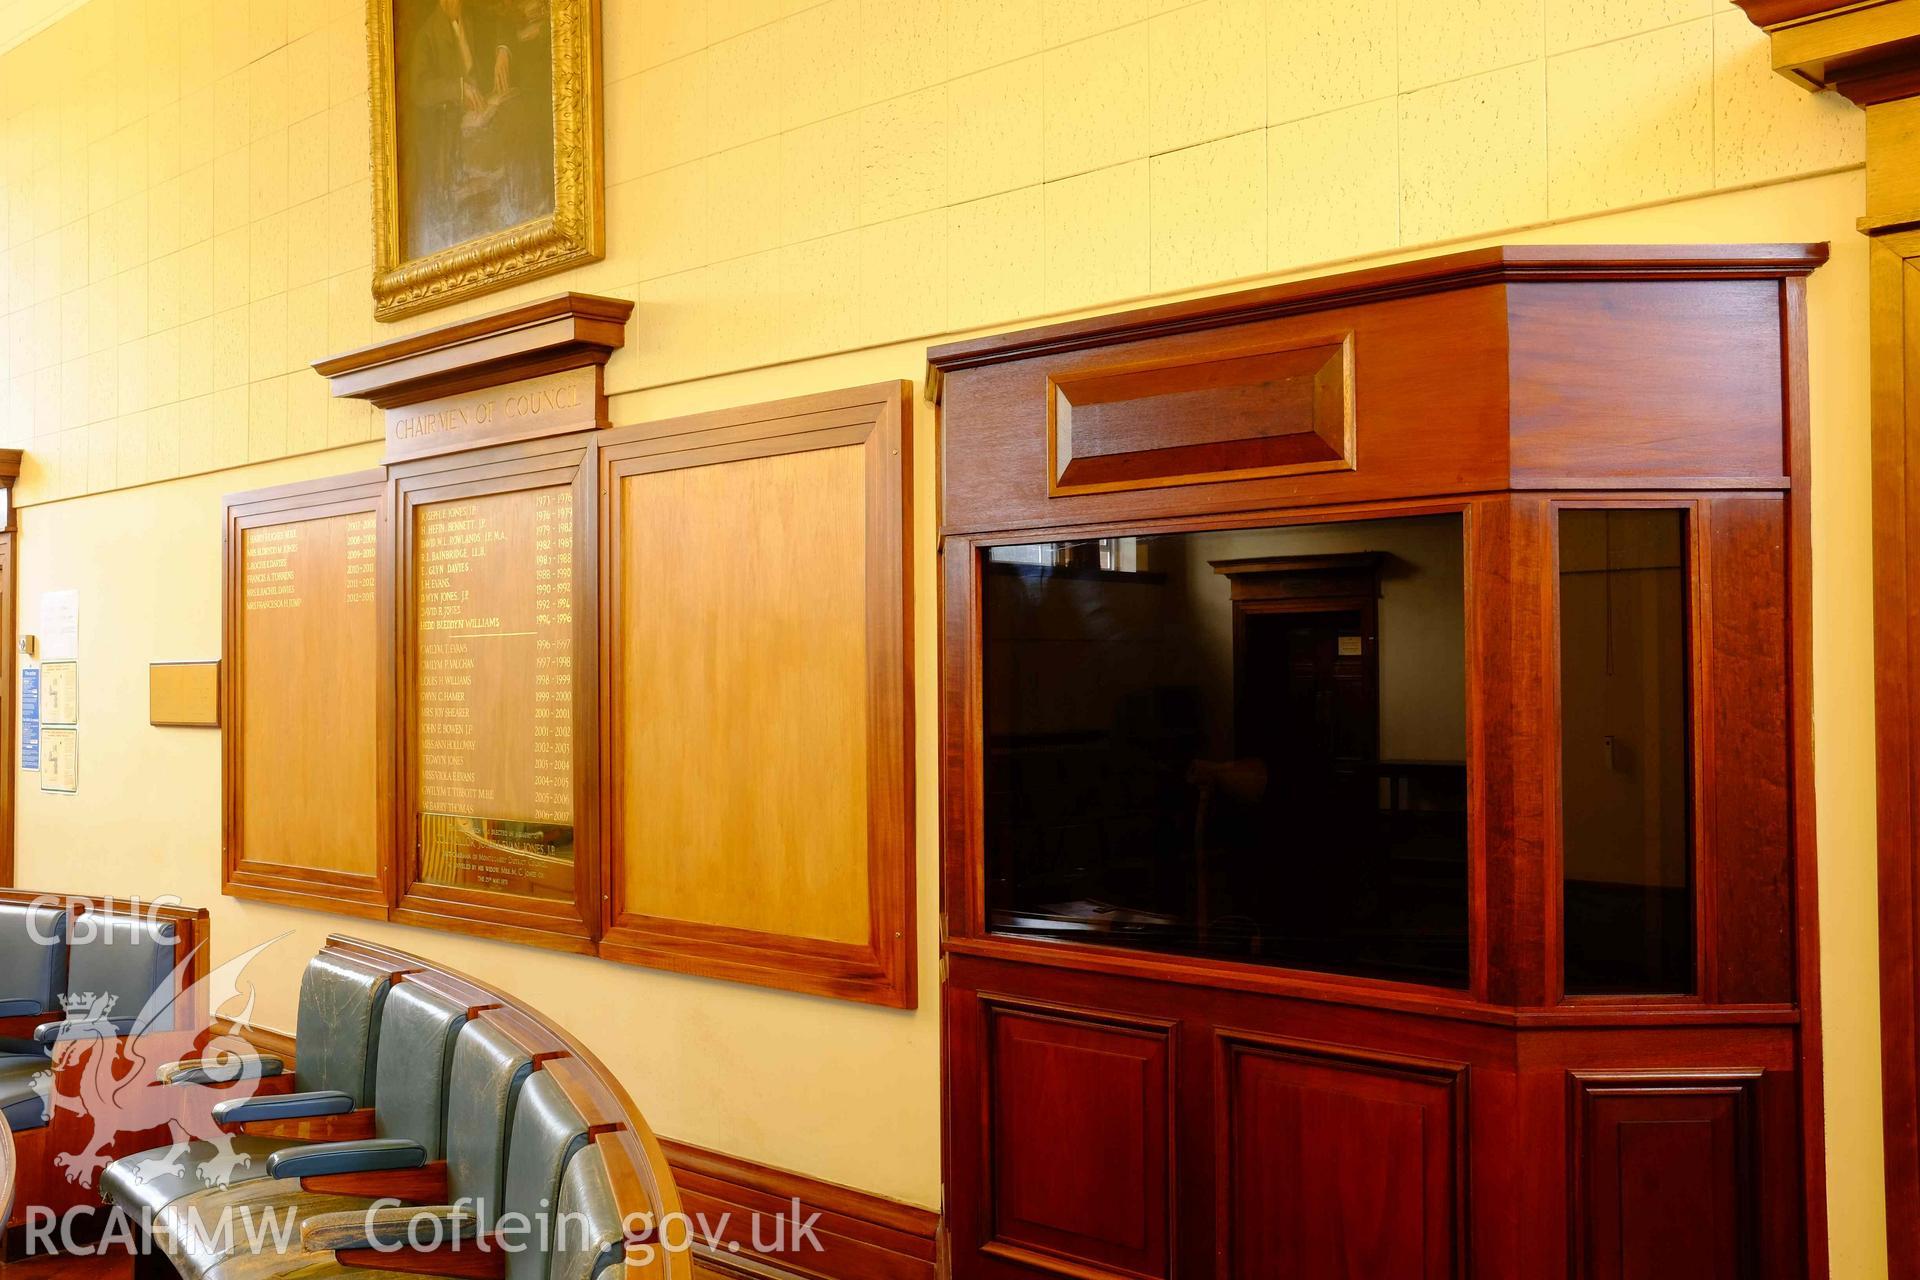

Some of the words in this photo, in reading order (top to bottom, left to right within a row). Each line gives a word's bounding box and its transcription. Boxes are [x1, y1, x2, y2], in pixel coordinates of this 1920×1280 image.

[395, 407, 469, 440] CHAIRMEN
[475, 401, 498, 424] OF
[504, 385, 582, 419] COUNCIL
[465, 617, 501, 629] WILLIAMS
[444, 674, 472, 686] WILLIAMS
[534, 725, 549, 737] 2001
[554, 725, 572, 738] 2002
[534, 741, 550, 753] 2002
[553, 759, 570, 771] 2004
[553, 810, 570, 822] 2007
